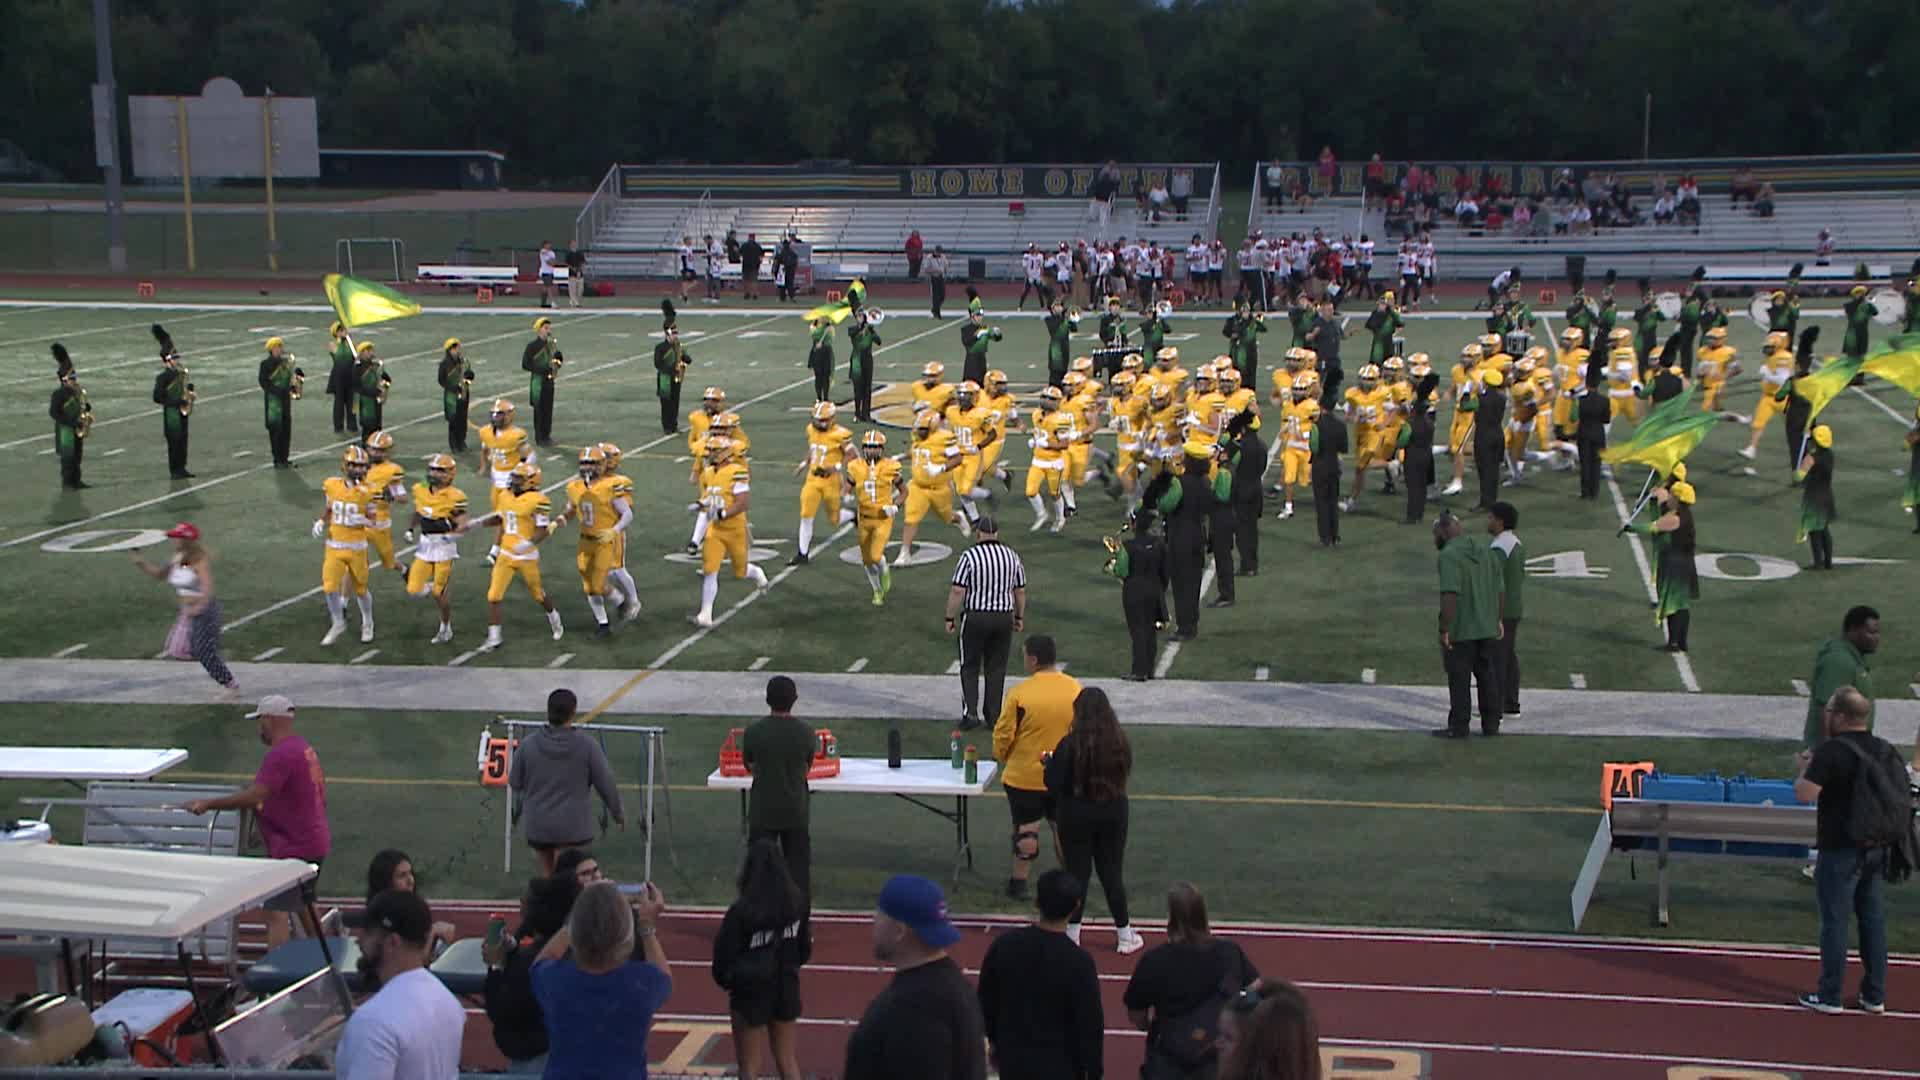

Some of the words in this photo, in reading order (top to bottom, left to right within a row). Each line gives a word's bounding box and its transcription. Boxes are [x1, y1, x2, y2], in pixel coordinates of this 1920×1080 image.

[911, 167, 1024, 196] HOME
[1044, 167, 1094, 196] OF
[1118, 167, 1194, 195] TH
[491, 745, 506, 778] 5
